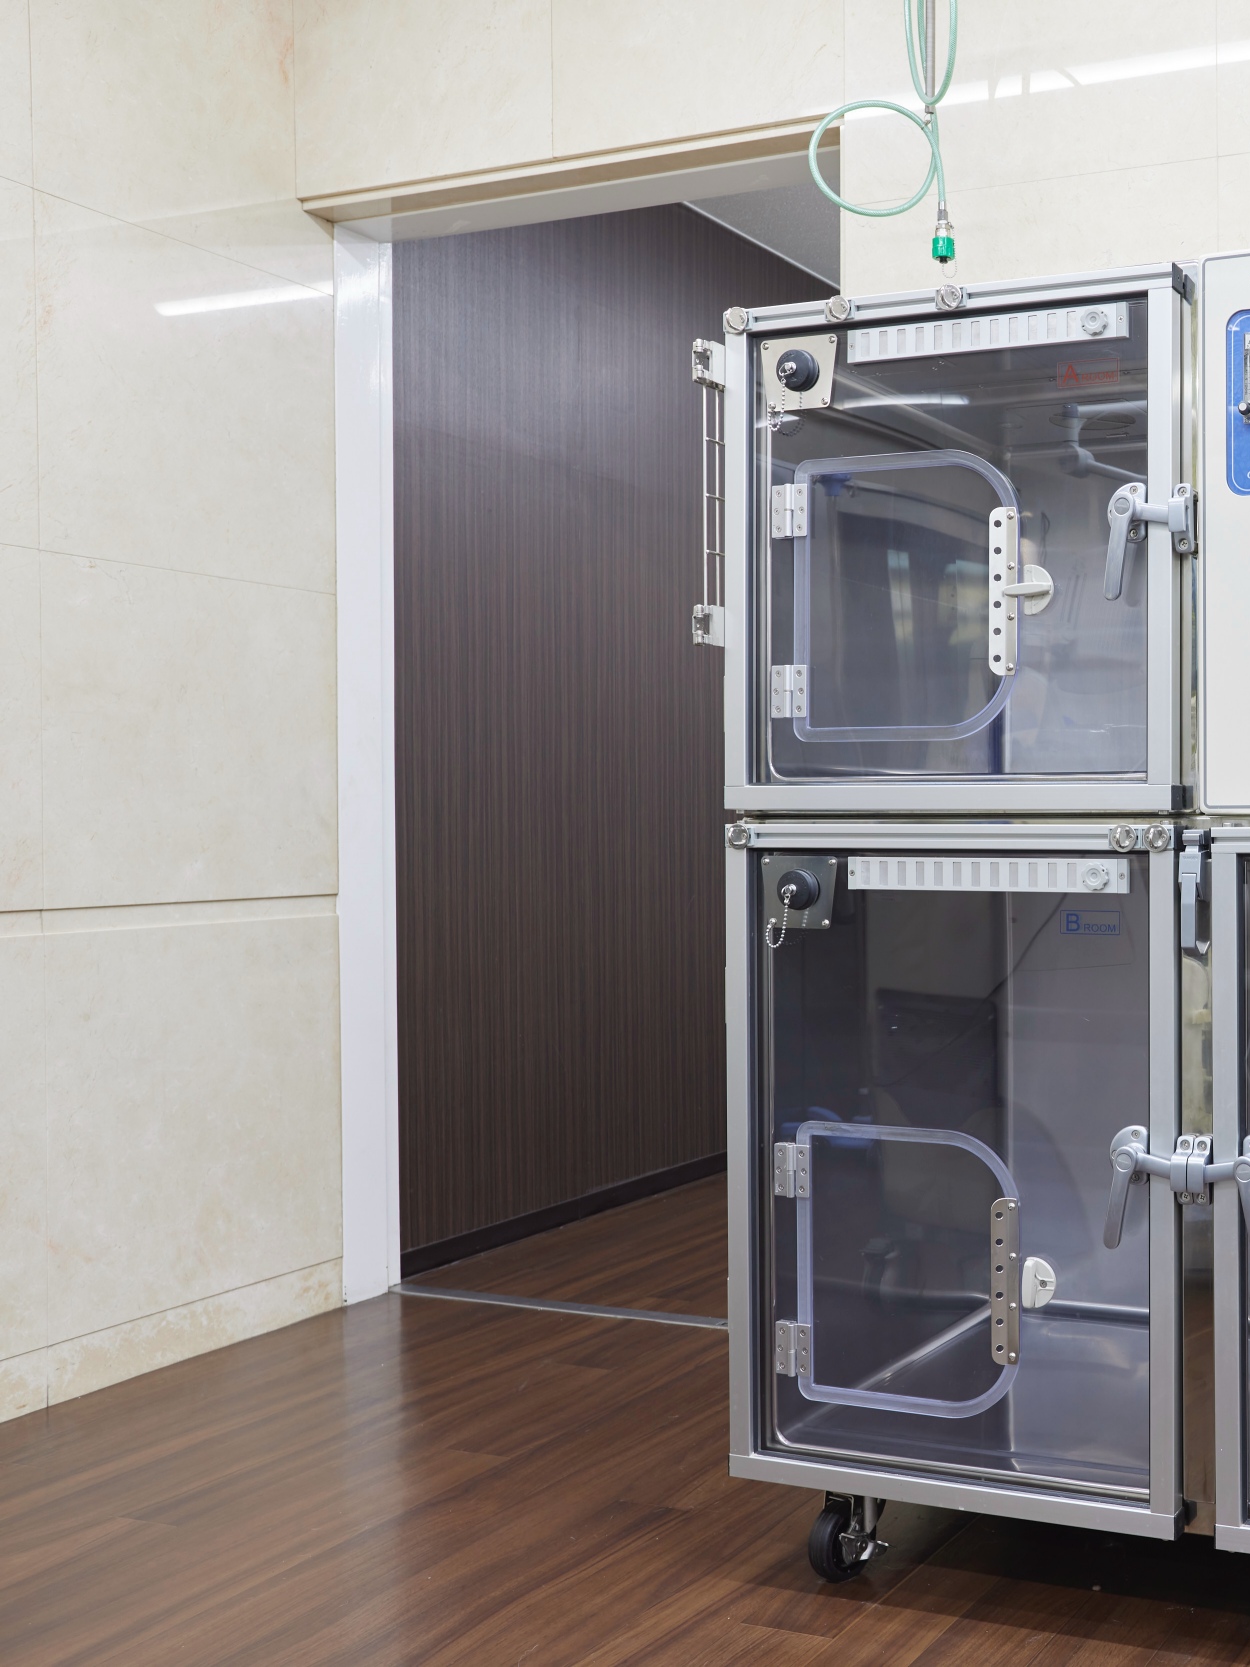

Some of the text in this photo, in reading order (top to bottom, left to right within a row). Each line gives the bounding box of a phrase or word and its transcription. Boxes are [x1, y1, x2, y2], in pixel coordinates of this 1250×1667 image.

[1062, 363, 1079, 385] A
[1065, 913, 1117, 933] B ROOM
